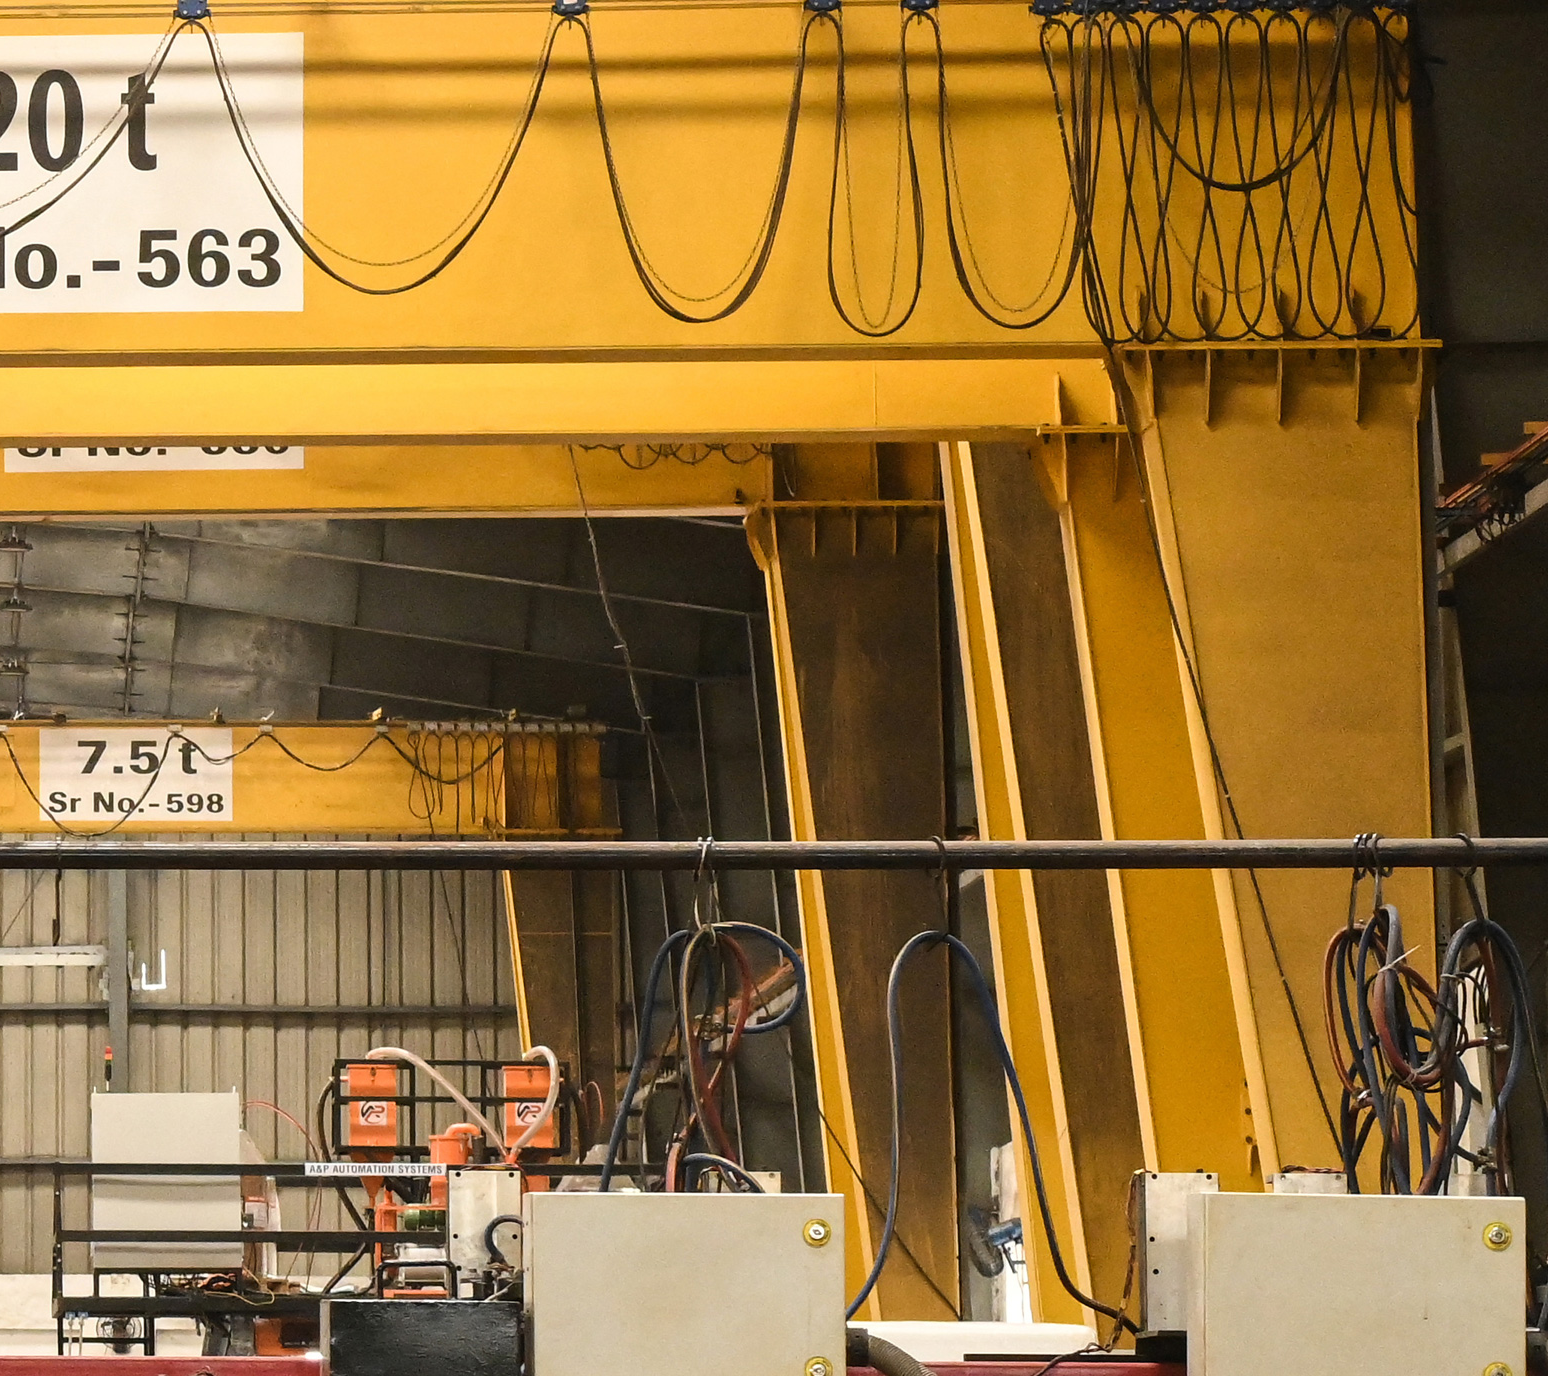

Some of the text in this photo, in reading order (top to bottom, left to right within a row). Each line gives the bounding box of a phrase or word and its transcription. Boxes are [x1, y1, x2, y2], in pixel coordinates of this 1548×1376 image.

[121, 73, 158, 171] t
[77, 740, 198, 775] 7.5 t
[48, 792, 81, 813] Sr
[309, 1164, 443, 1174] A&P AUTOMATION SYSTEMS
